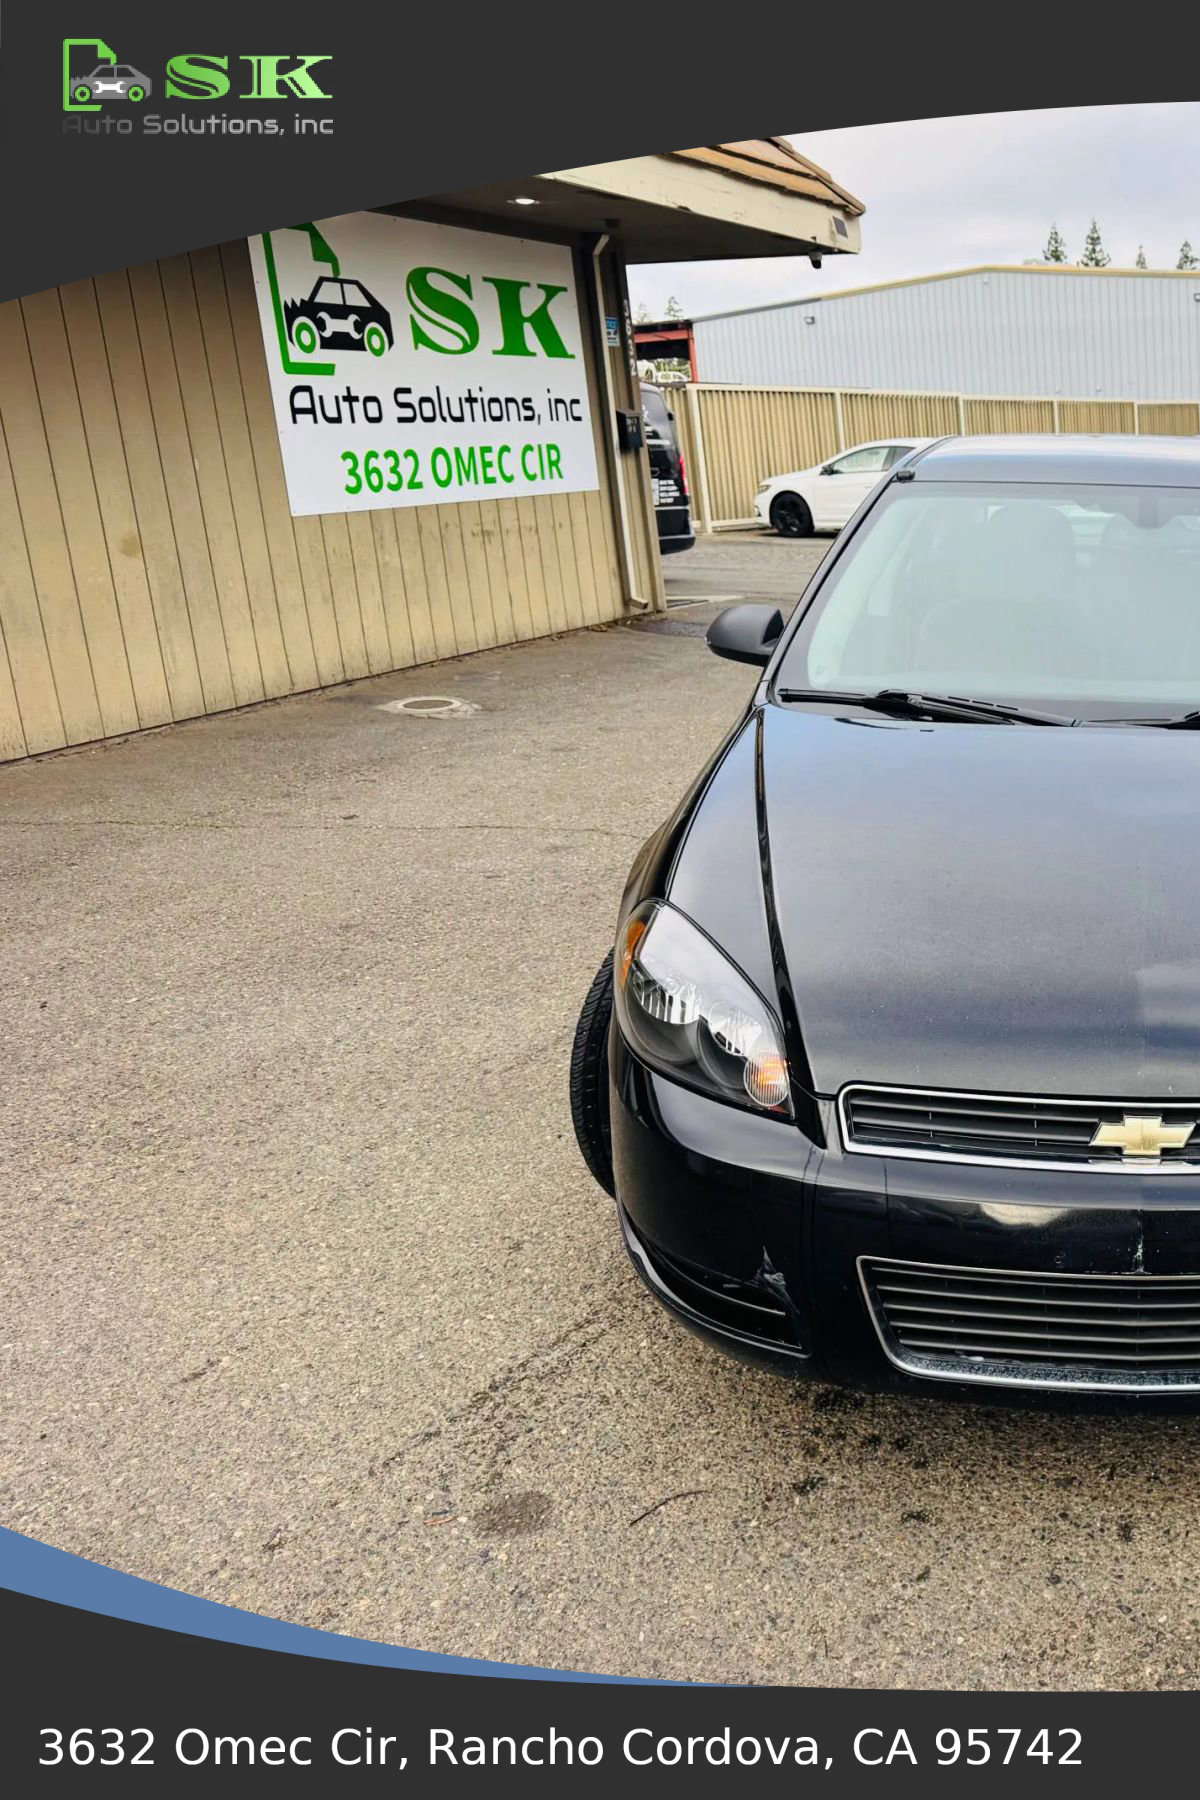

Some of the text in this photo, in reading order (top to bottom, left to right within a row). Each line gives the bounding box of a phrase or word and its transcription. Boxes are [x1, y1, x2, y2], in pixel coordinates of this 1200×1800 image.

[405, 266, 576, 360] SK
[289, 384, 583, 426] Auto Solutions, inc
[341, 443, 564, 495] 3632 OMEC CIR
